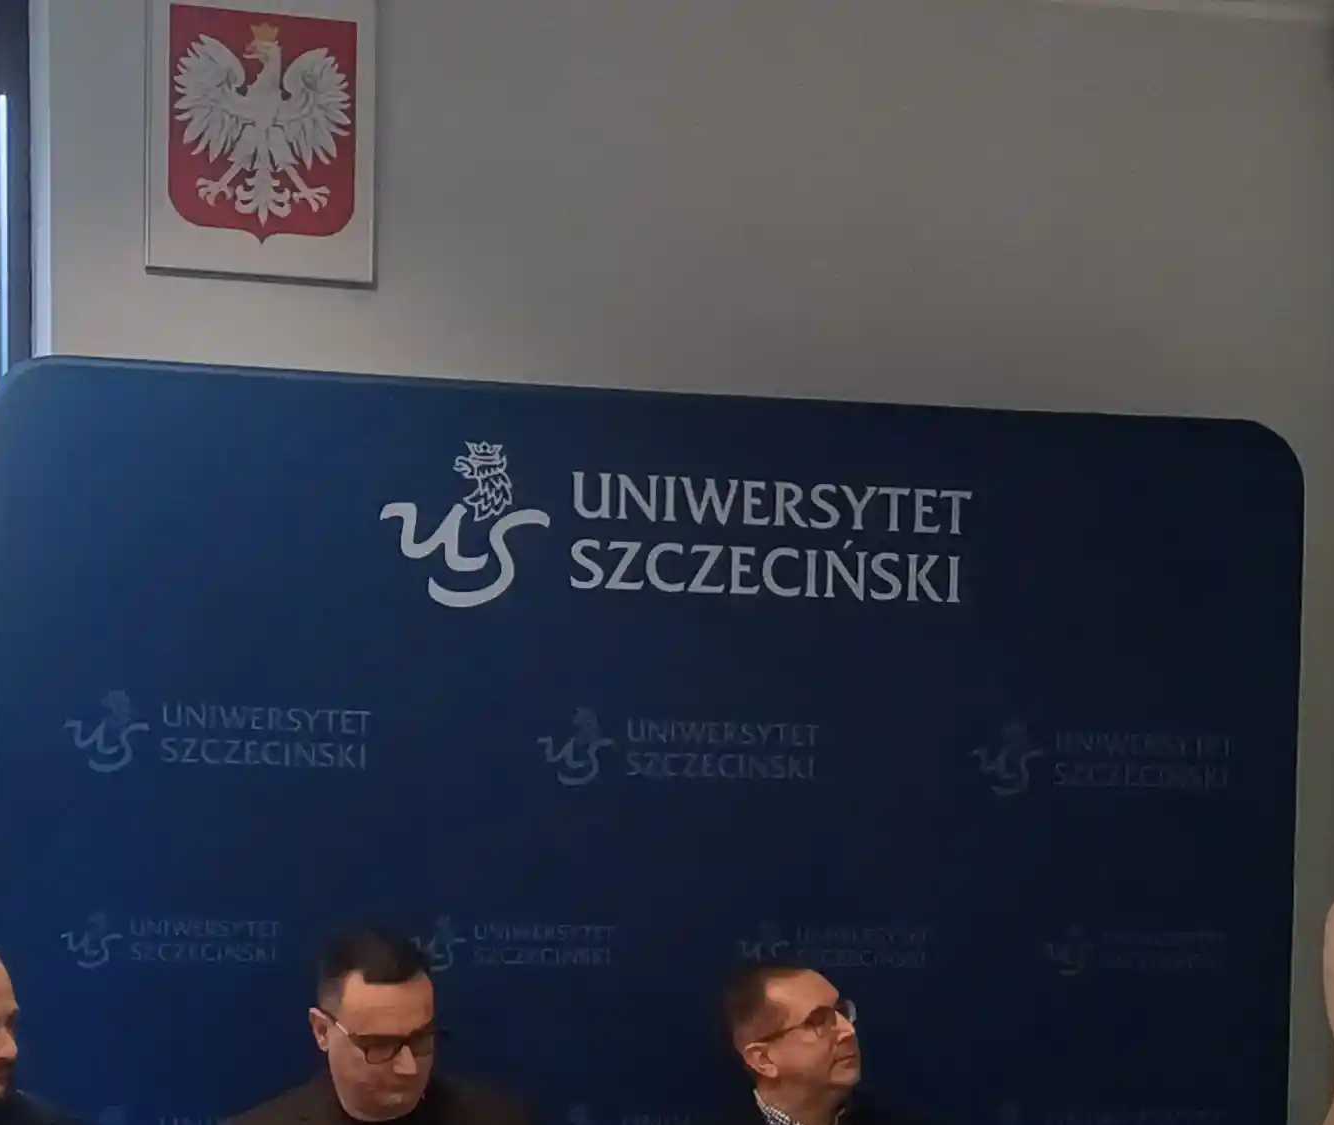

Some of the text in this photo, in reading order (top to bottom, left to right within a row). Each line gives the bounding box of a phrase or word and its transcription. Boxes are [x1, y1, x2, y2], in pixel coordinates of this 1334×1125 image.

[570, 470, 972, 536] UNIWERSYTET
[569, 537, 961, 603] SZCZECIŃSKI
[163, 702, 371, 733] UNIWERSYTET
[627, 718, 820, 746] UNIWERSYTET
